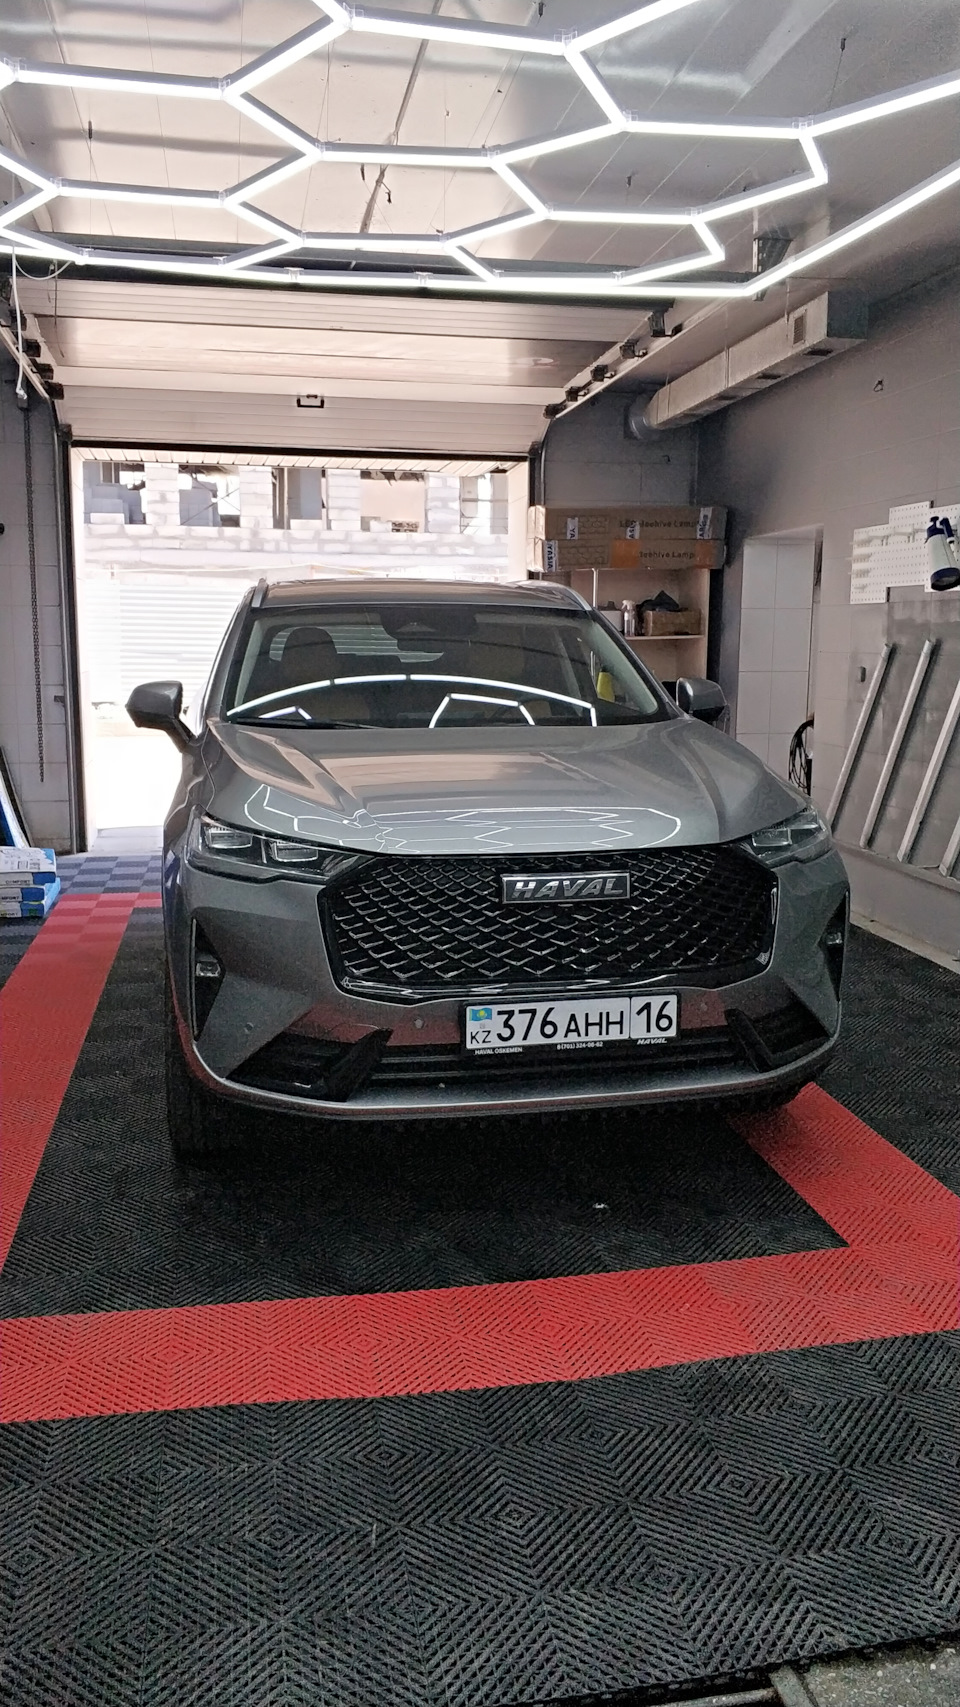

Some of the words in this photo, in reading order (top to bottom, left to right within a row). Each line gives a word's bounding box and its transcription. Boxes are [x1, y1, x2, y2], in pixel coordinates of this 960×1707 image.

[511, 878, 623, 898] HAVAL
[635, 1000, 673, 1034] 16
[470, 1029, 491, 1045] KZ
[636, 1037, 667, 1045] HAVAL
